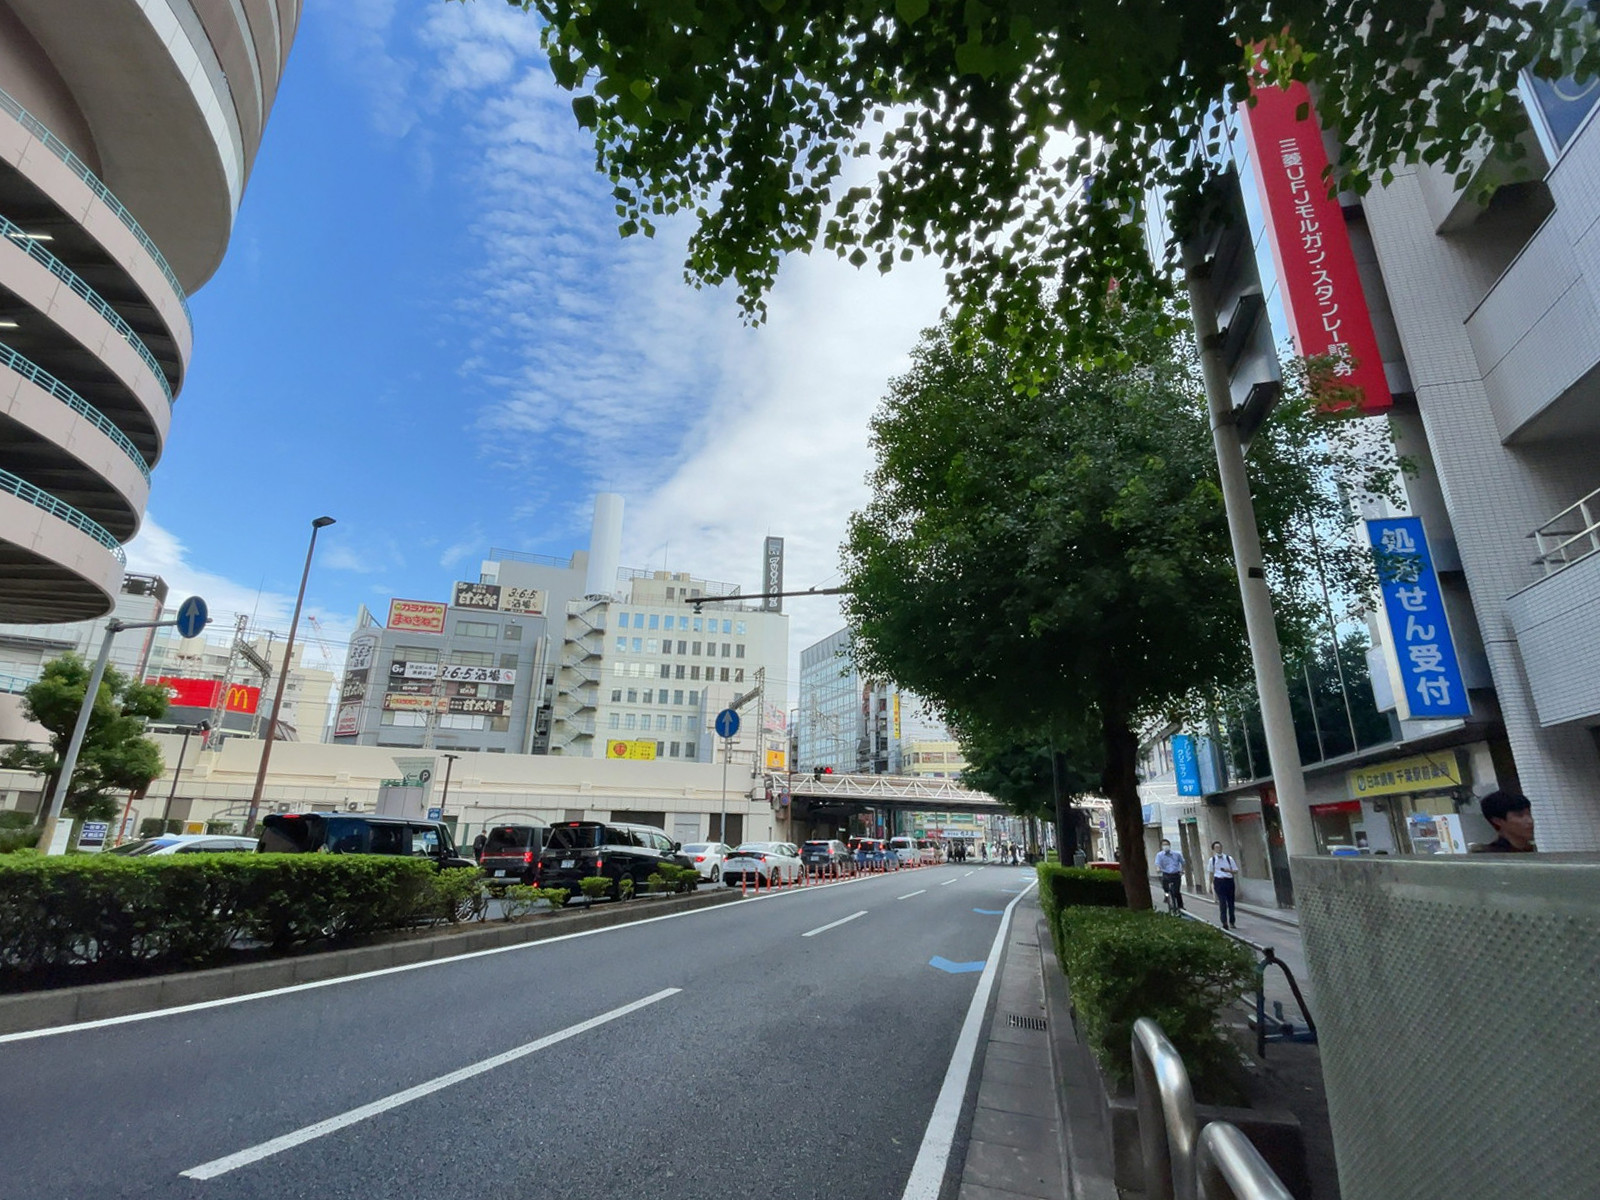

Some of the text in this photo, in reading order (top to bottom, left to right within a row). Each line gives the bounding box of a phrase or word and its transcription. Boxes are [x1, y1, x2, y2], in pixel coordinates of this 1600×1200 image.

[1278, 137, 1355, 377] 三菱UFJモルガン・スタンレー証券
